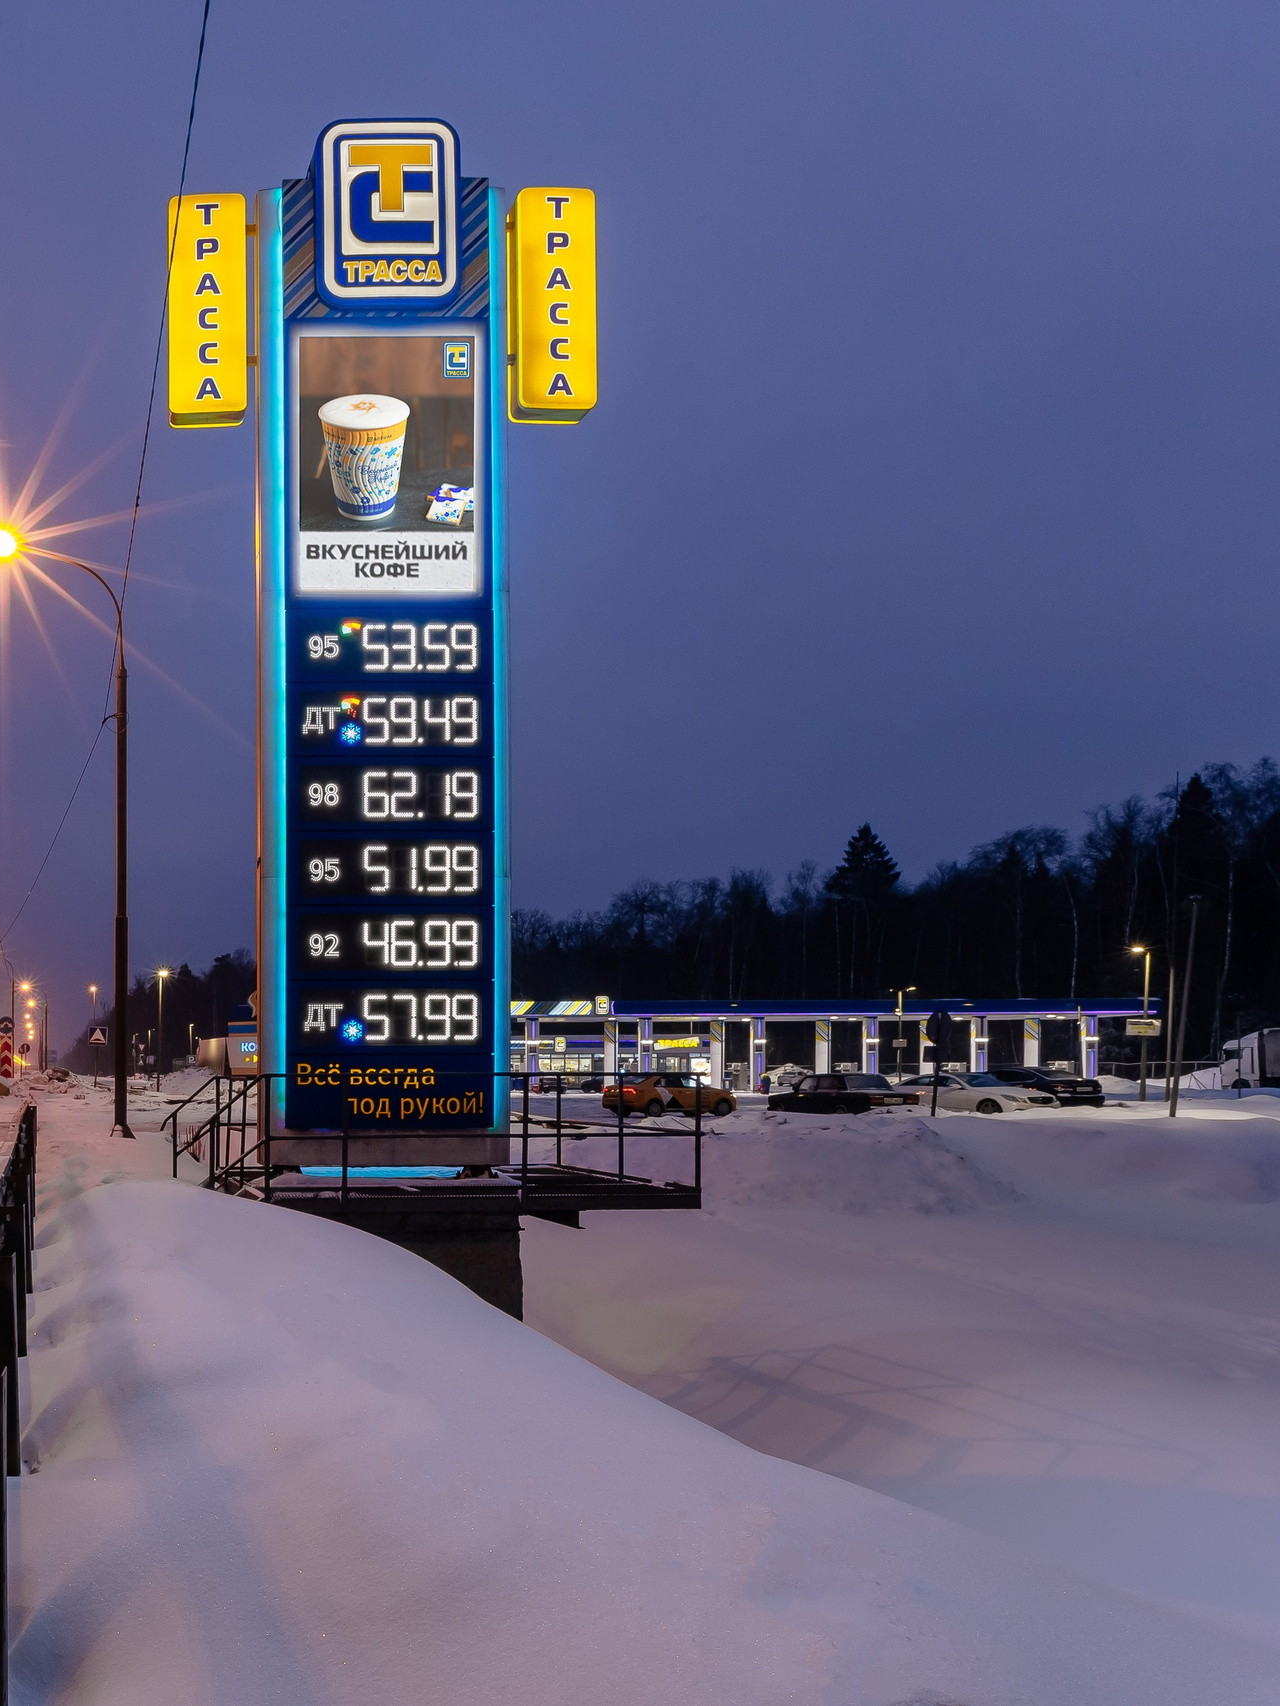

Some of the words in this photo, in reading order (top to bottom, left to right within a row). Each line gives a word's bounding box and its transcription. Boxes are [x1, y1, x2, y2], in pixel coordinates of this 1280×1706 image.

[343, 260, 442, 283] ТРАССА
[194, 203, 222, 400] ТРАССА
[546, 197, 573, 396] ТРАССА
[306, 541, 468, 560] ВКУСНЕЙШИЙ
[355, 562, 419, 578] КОФЕ
[308, 635, 339, 658] 95
[362, 624, 477, 670] 53.59
[302, 706, 341, 734] ДТ
[362, 697, 477, 743] 59.49
[308, 783, 339, 806] 98
[363, 771, 478, 817] 62.19
[309, 858, 340, 882] 95
[363, 846, 478, 891] 51.99
[309, 934, 340, 957] 92
[363, 920, 478, 966] 46.99
[304, 1003, 343, 1032] ДТ
[363, 994, 478, 1040] 57.99
[657, 1039, 698, 1048] ТРАССА
[297, 1063, 340, 1085] Всё
[350, 1068, 435, 1089] всегда
[400, 1091, 484, 1119] рукой!
